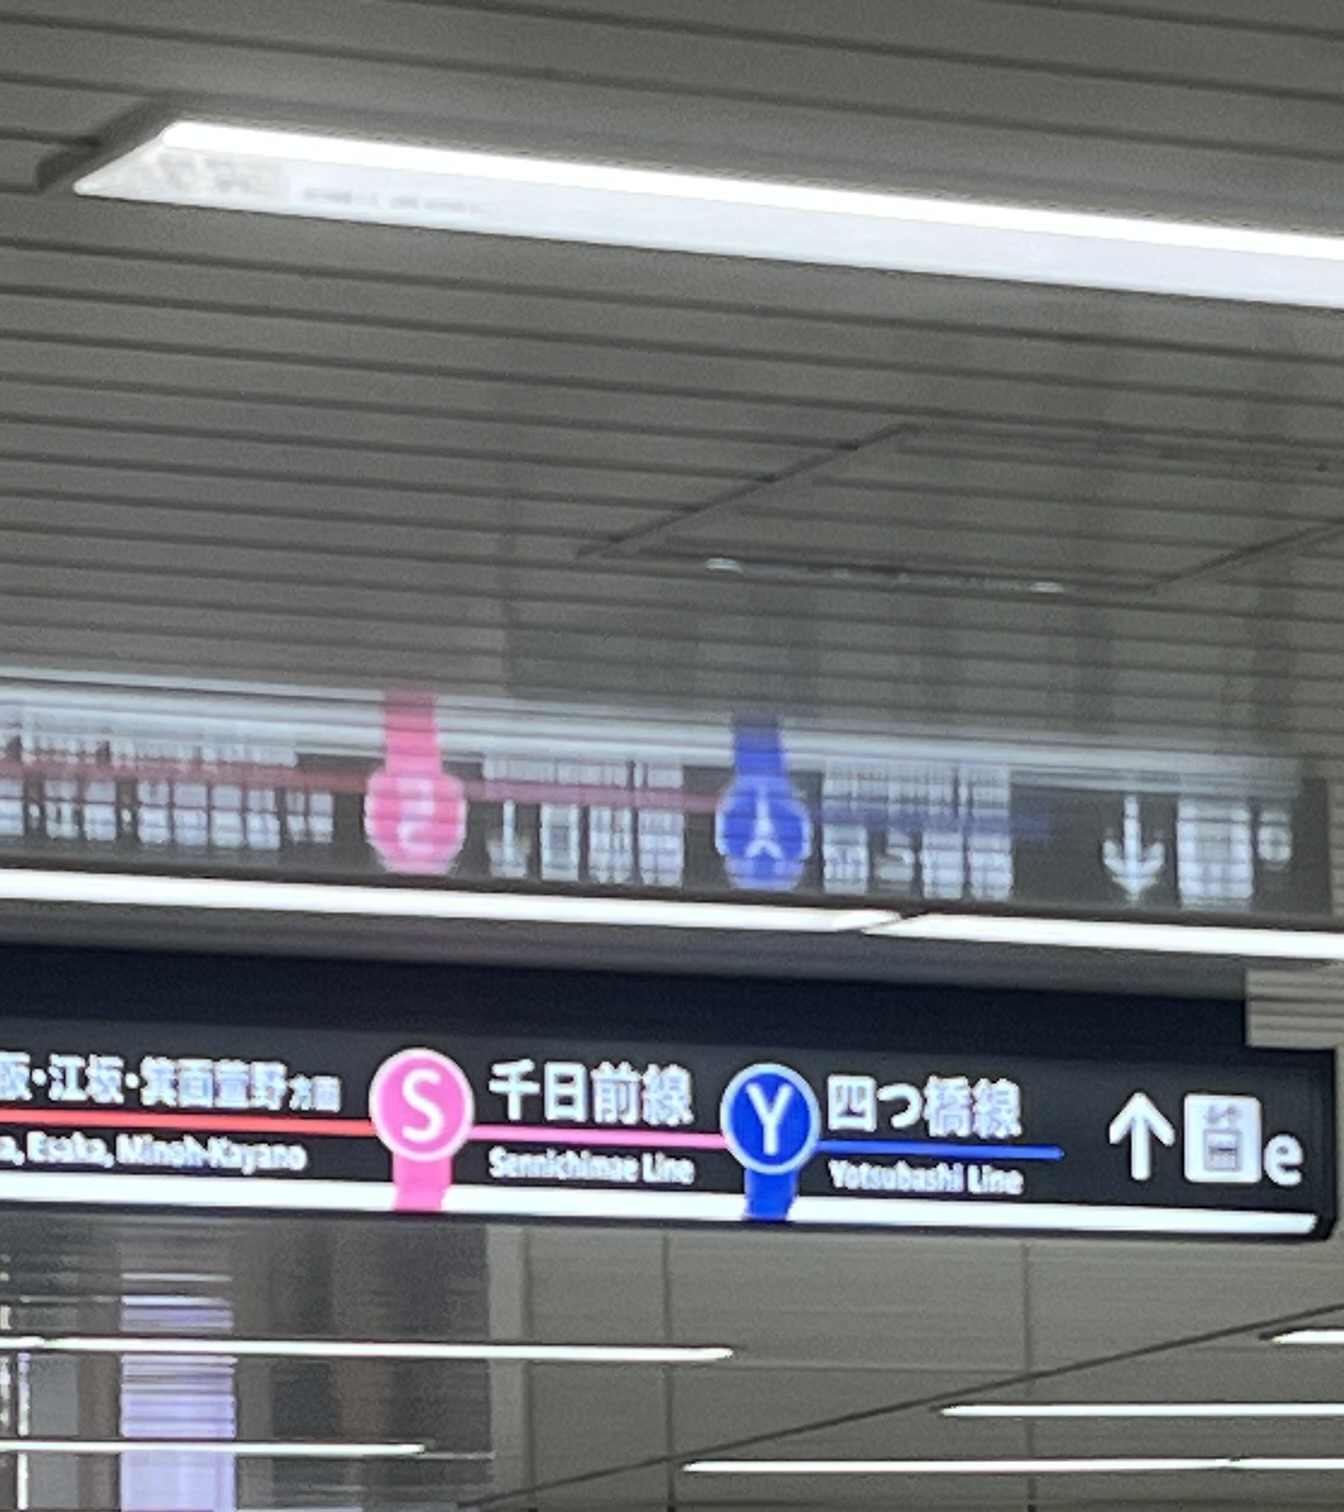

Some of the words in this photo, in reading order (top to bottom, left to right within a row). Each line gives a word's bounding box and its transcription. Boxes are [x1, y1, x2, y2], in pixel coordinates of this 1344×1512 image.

[401, 1067, 444, 1143] S
[488, 1057, 694, 1126] 千日前線
[745, 1081, 793, 1156] Y
[826, 1073, 1023, 1140] 四つ橋線
[641, 1152, 695, 1185] Line
[828, 1159, 964, 1193] Yotsubashi
[967, 1163, 1025, 1195] Line
